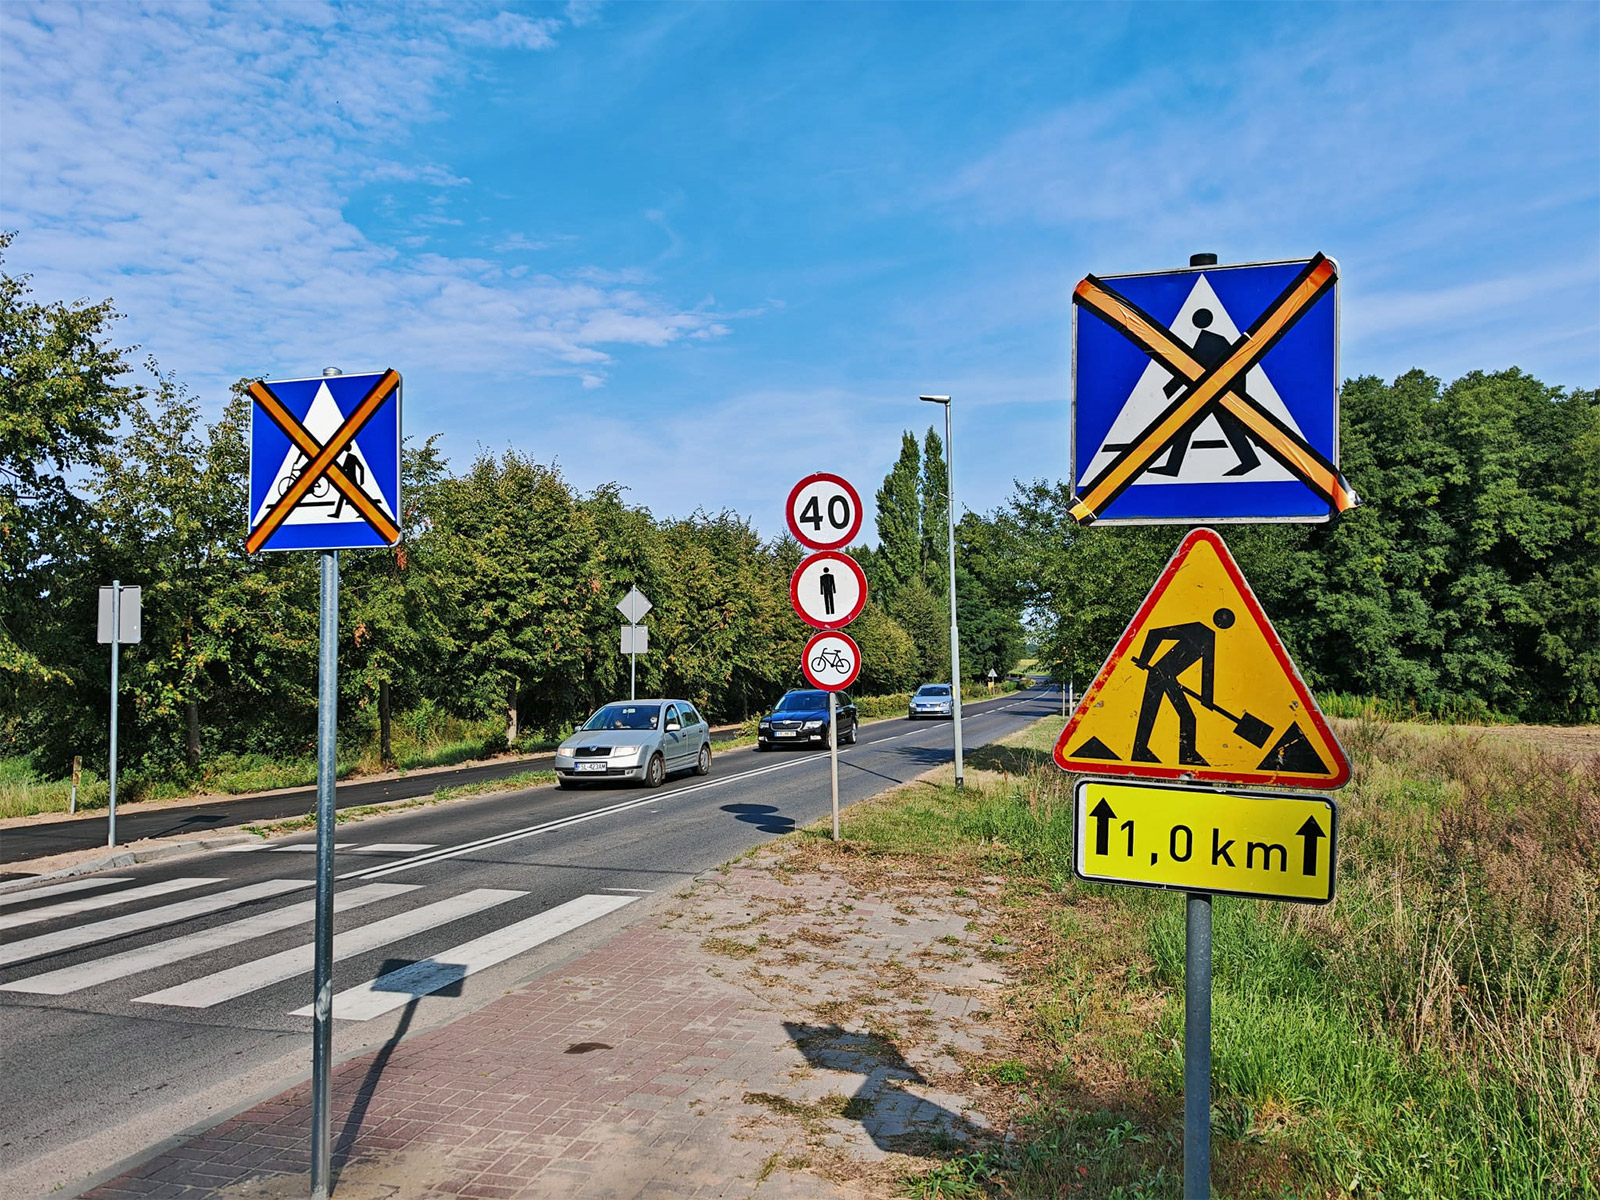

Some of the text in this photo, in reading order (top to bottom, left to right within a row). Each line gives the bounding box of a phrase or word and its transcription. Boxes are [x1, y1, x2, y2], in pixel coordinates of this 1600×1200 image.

[799, 494, 851, 531] 40
[1120, 819, 1288, 873] 1,0 km
